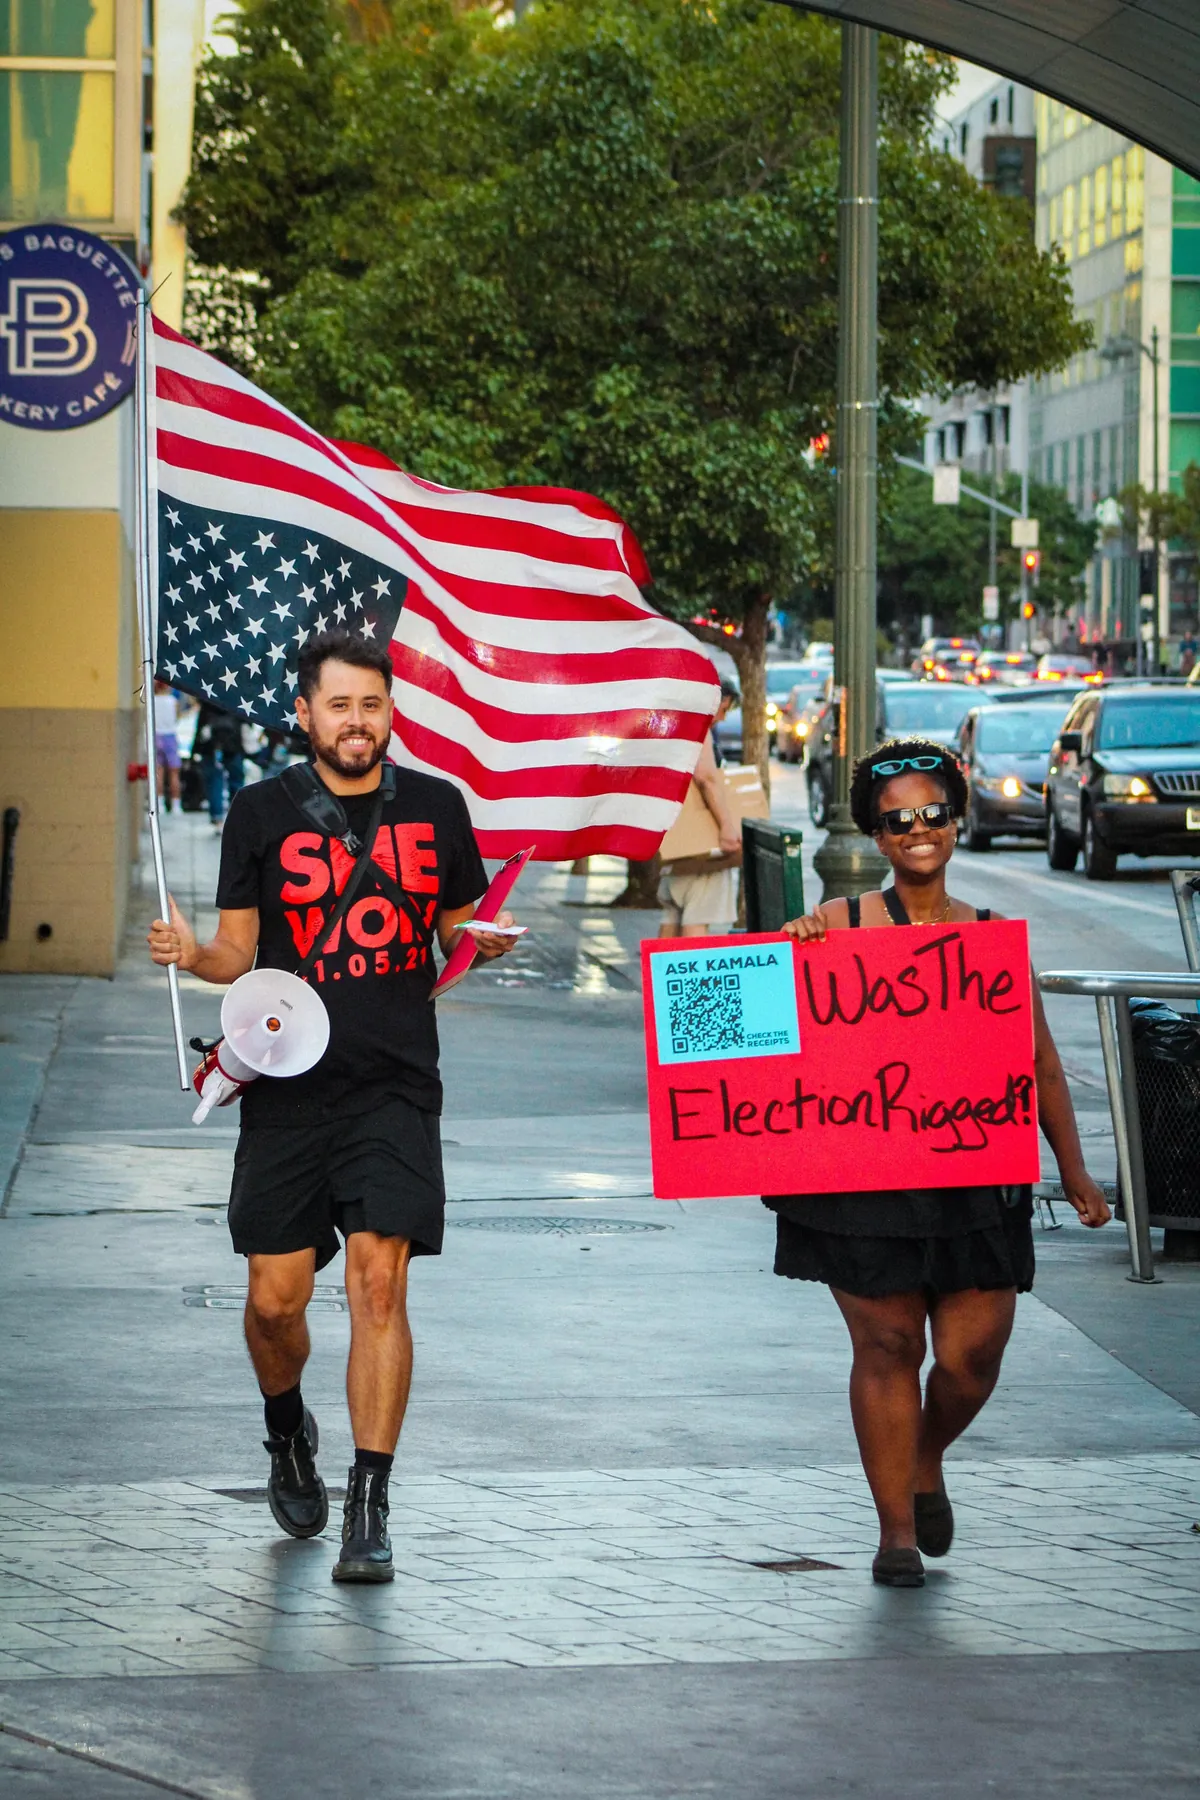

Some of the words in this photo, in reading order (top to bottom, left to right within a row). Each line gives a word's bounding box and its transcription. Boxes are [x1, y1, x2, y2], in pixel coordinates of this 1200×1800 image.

[24, 233, 139, 308] BAGUETTE
[665, 961, 699, 975] ASK
[706, 954, 778, 972] KAMALA
[747, 1032, 772, 1040] CHECK
[773, 1030, 788, 1038] THE
[747, 1037, 789, 1047] RECEIPTS
